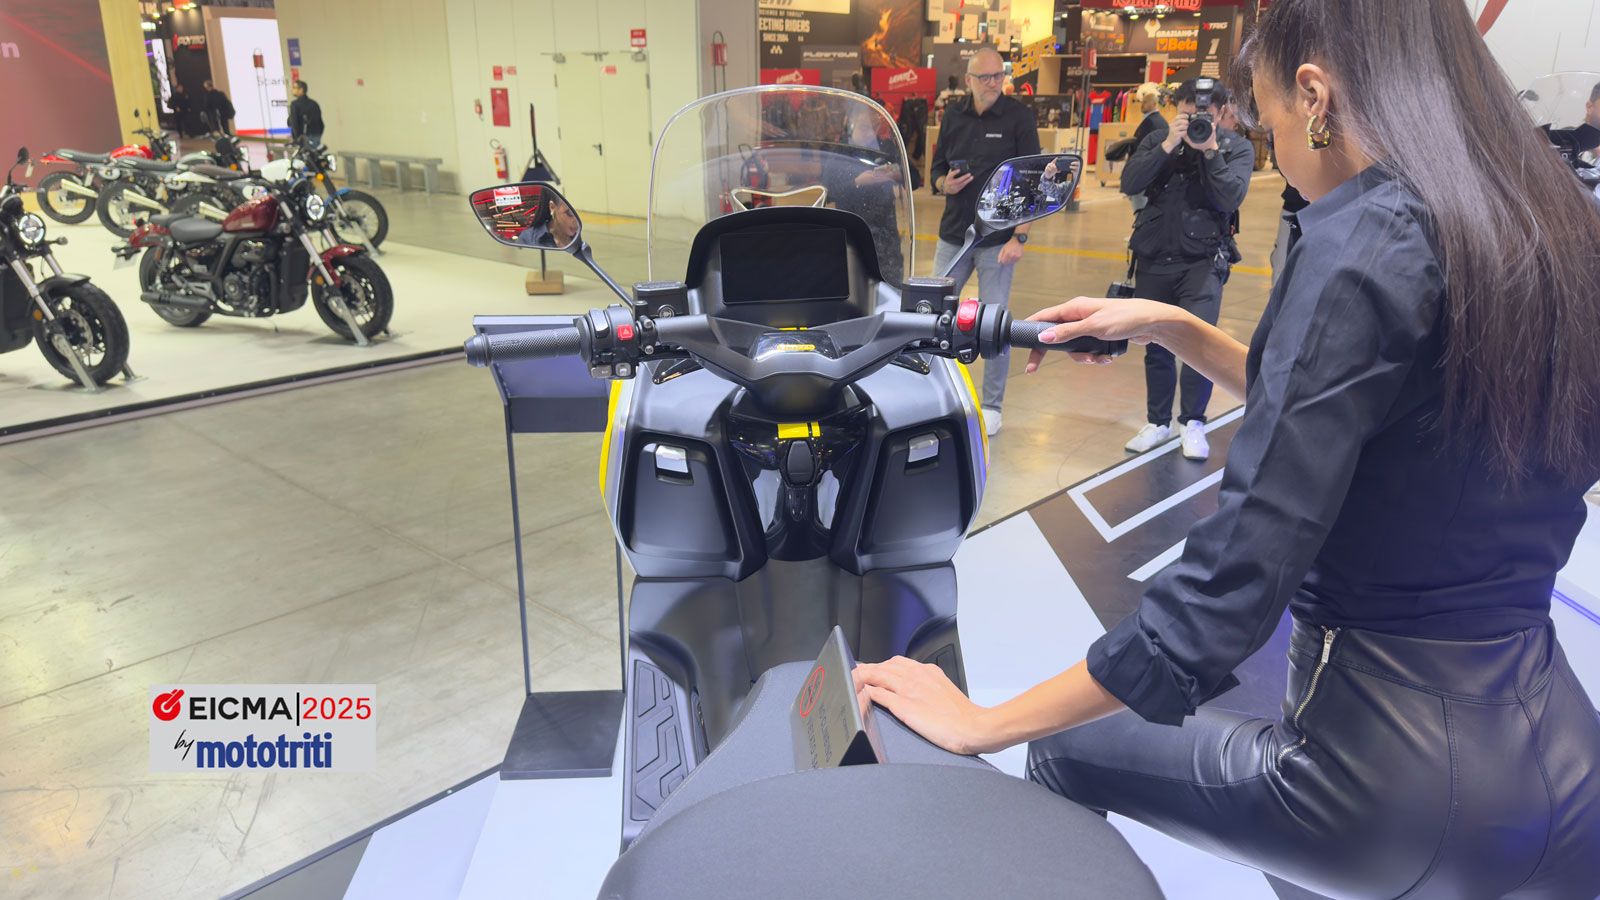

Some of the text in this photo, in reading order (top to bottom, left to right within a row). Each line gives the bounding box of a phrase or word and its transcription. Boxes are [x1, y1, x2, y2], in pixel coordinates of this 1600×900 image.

[759, 17, 811, 33] ECTING RIDERS
[0, 42, 20, 58] n
[1168, 37, 1198, 51] Beta
